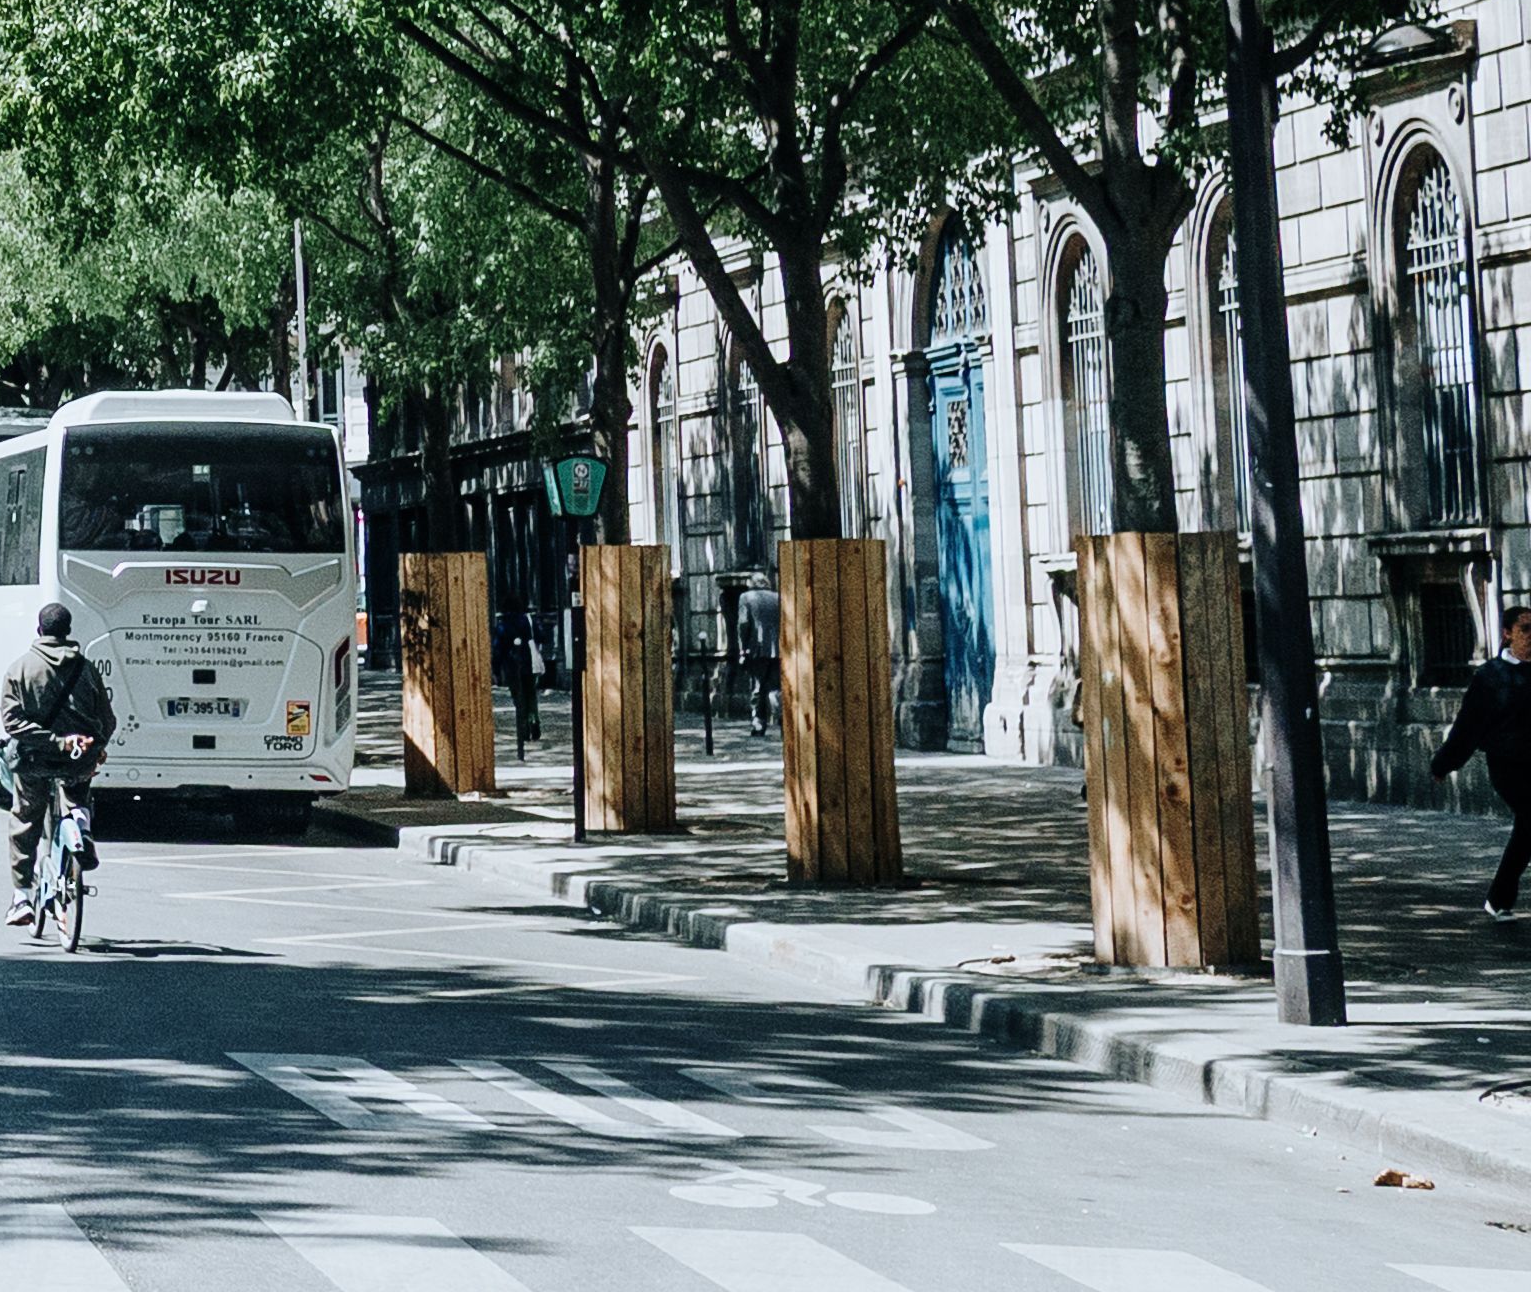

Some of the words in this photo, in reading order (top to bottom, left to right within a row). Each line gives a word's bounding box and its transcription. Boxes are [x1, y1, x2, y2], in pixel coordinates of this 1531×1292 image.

[165, 569, 240, 585] ISUZU
[142, 614, 186, 627] Europa
[191, 615, 220, 625] Tour
[225, 615, 261, 625] SARL
[125, 631, 202, 643] Montmorency
[207, 632, 240, 642] 95160
[245, 632, 284, 642] France
[93, 659, 112, 676] 00
[264, 742, 303, 751] TORO
[223, 1052, 998, 1151] BUS
